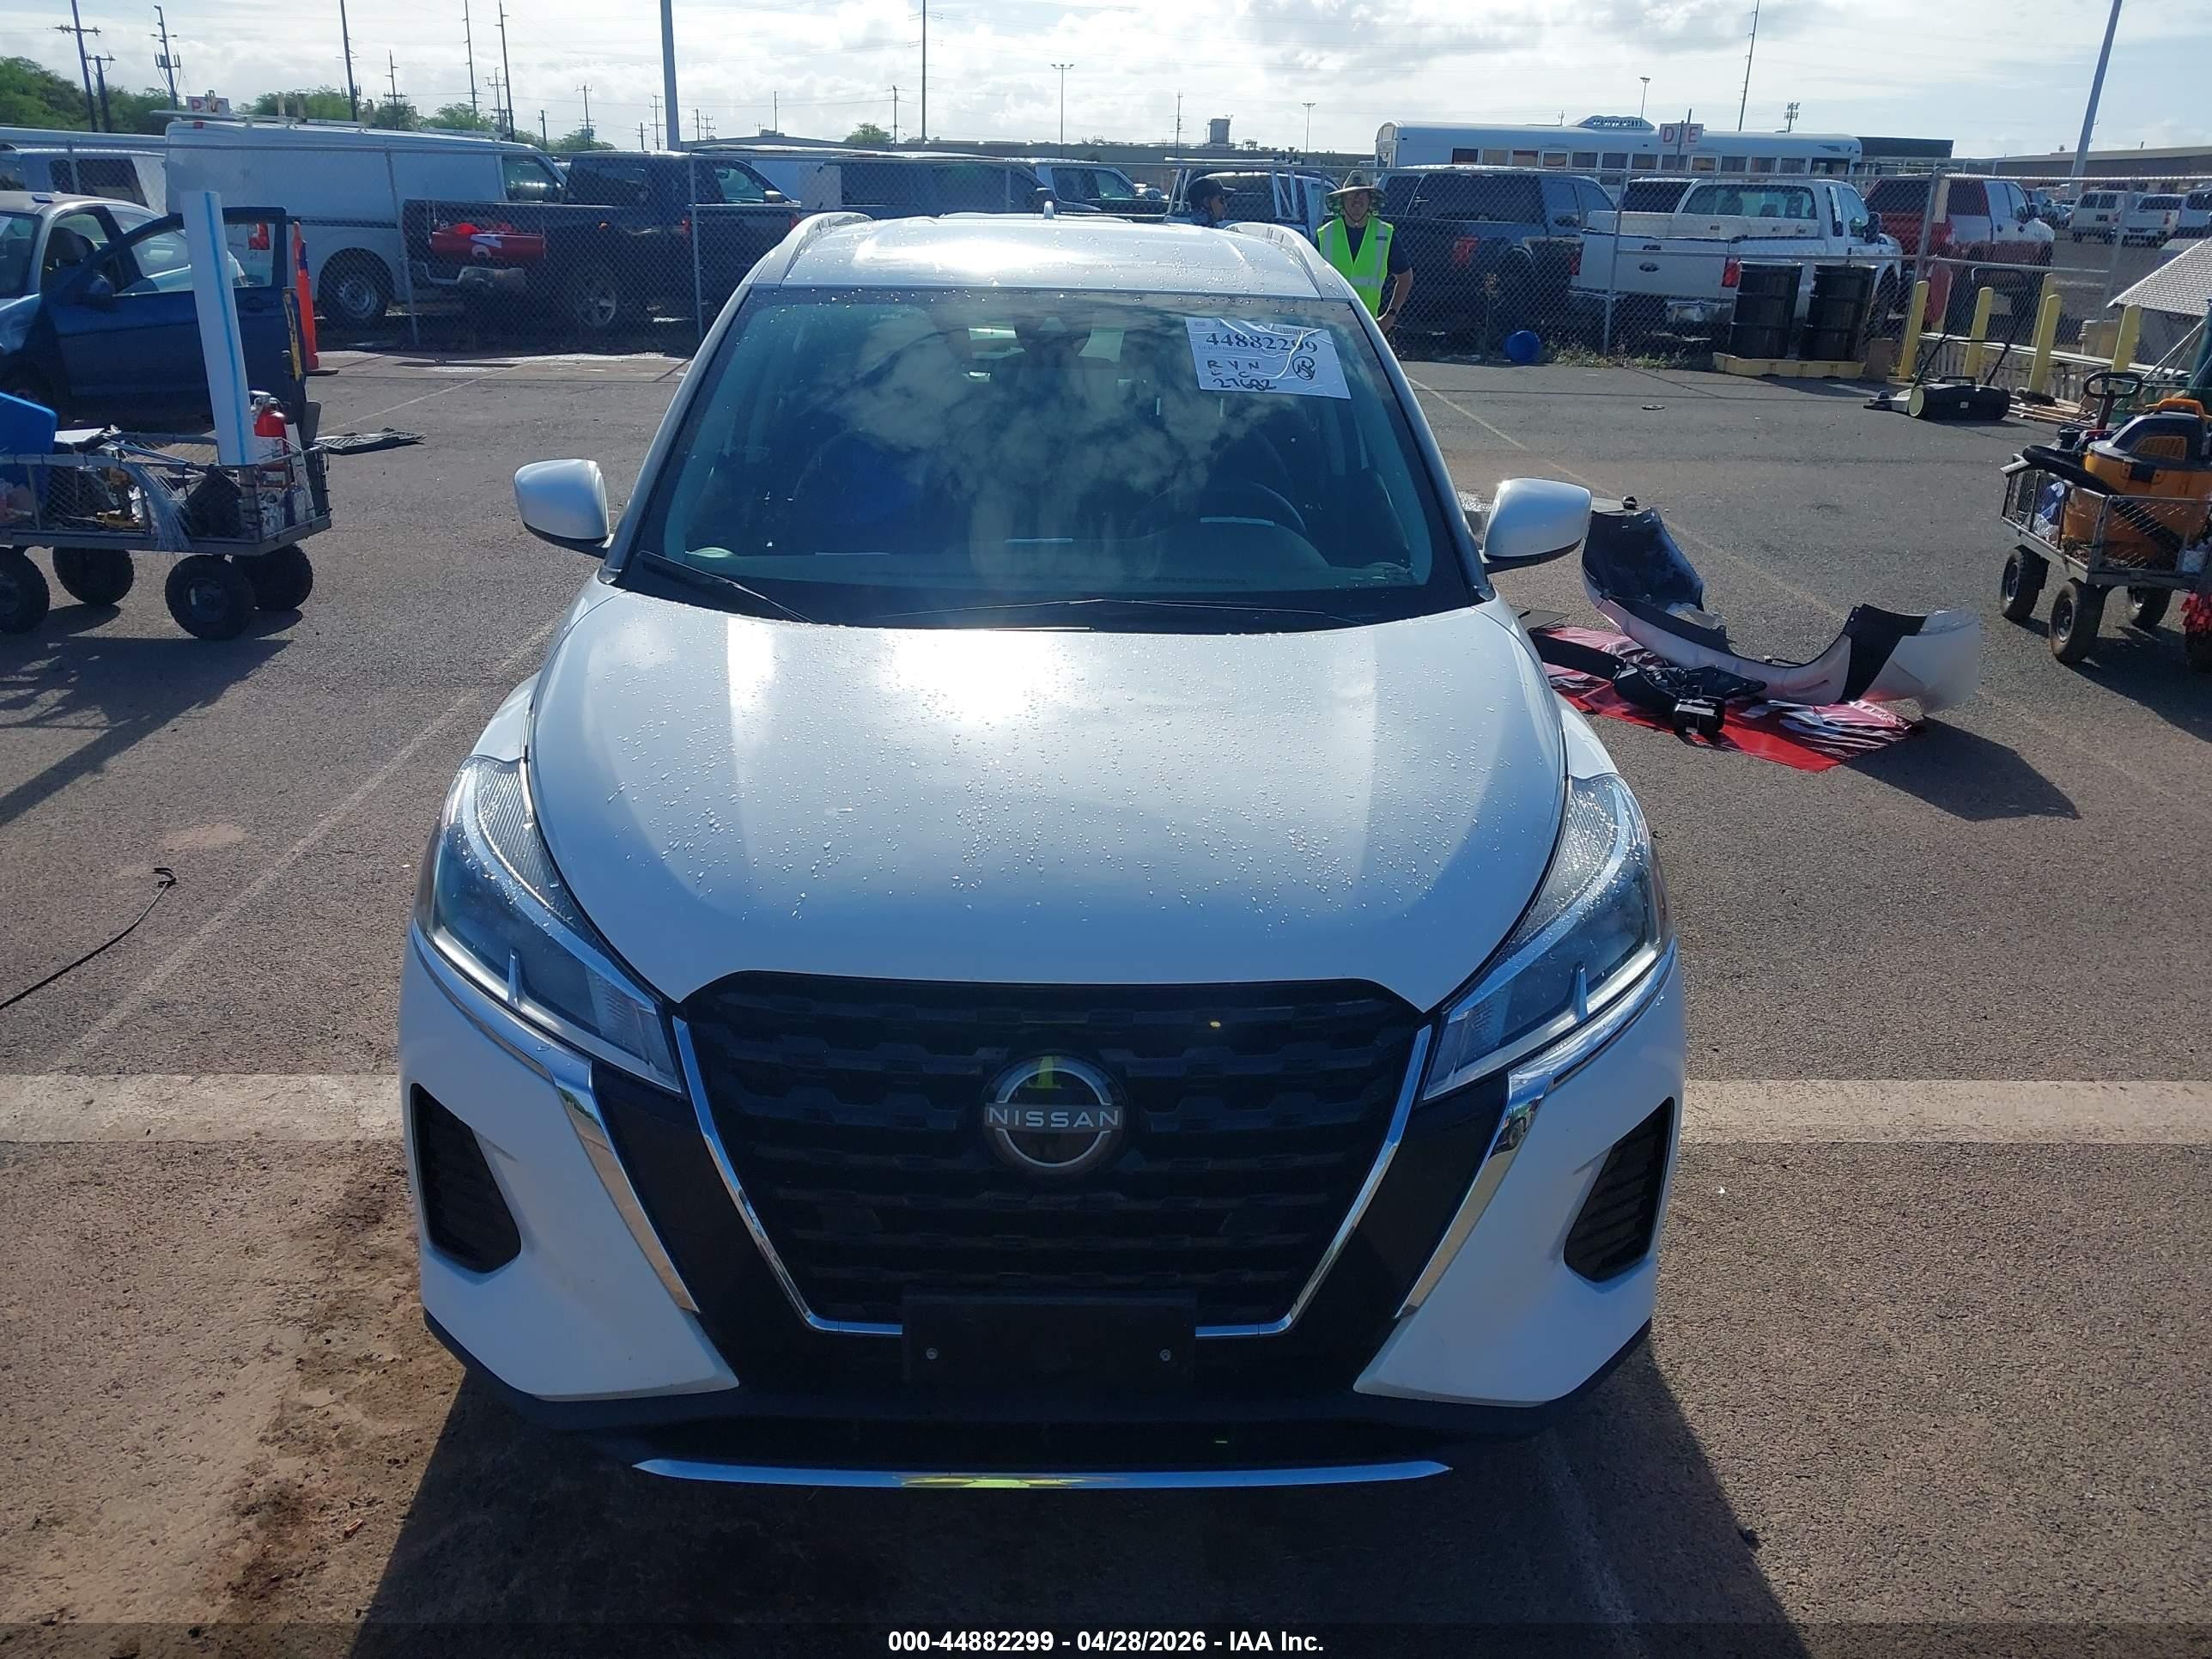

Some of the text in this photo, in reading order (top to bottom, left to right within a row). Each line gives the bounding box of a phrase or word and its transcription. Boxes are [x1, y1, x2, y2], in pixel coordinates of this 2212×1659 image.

[1662, 126, 1675, 143] D
[1687, 126, 1699, 143] E
[1206, 332, 1318, 353] 44882299
[988, 1107, 1119, 1128] NISSAN
